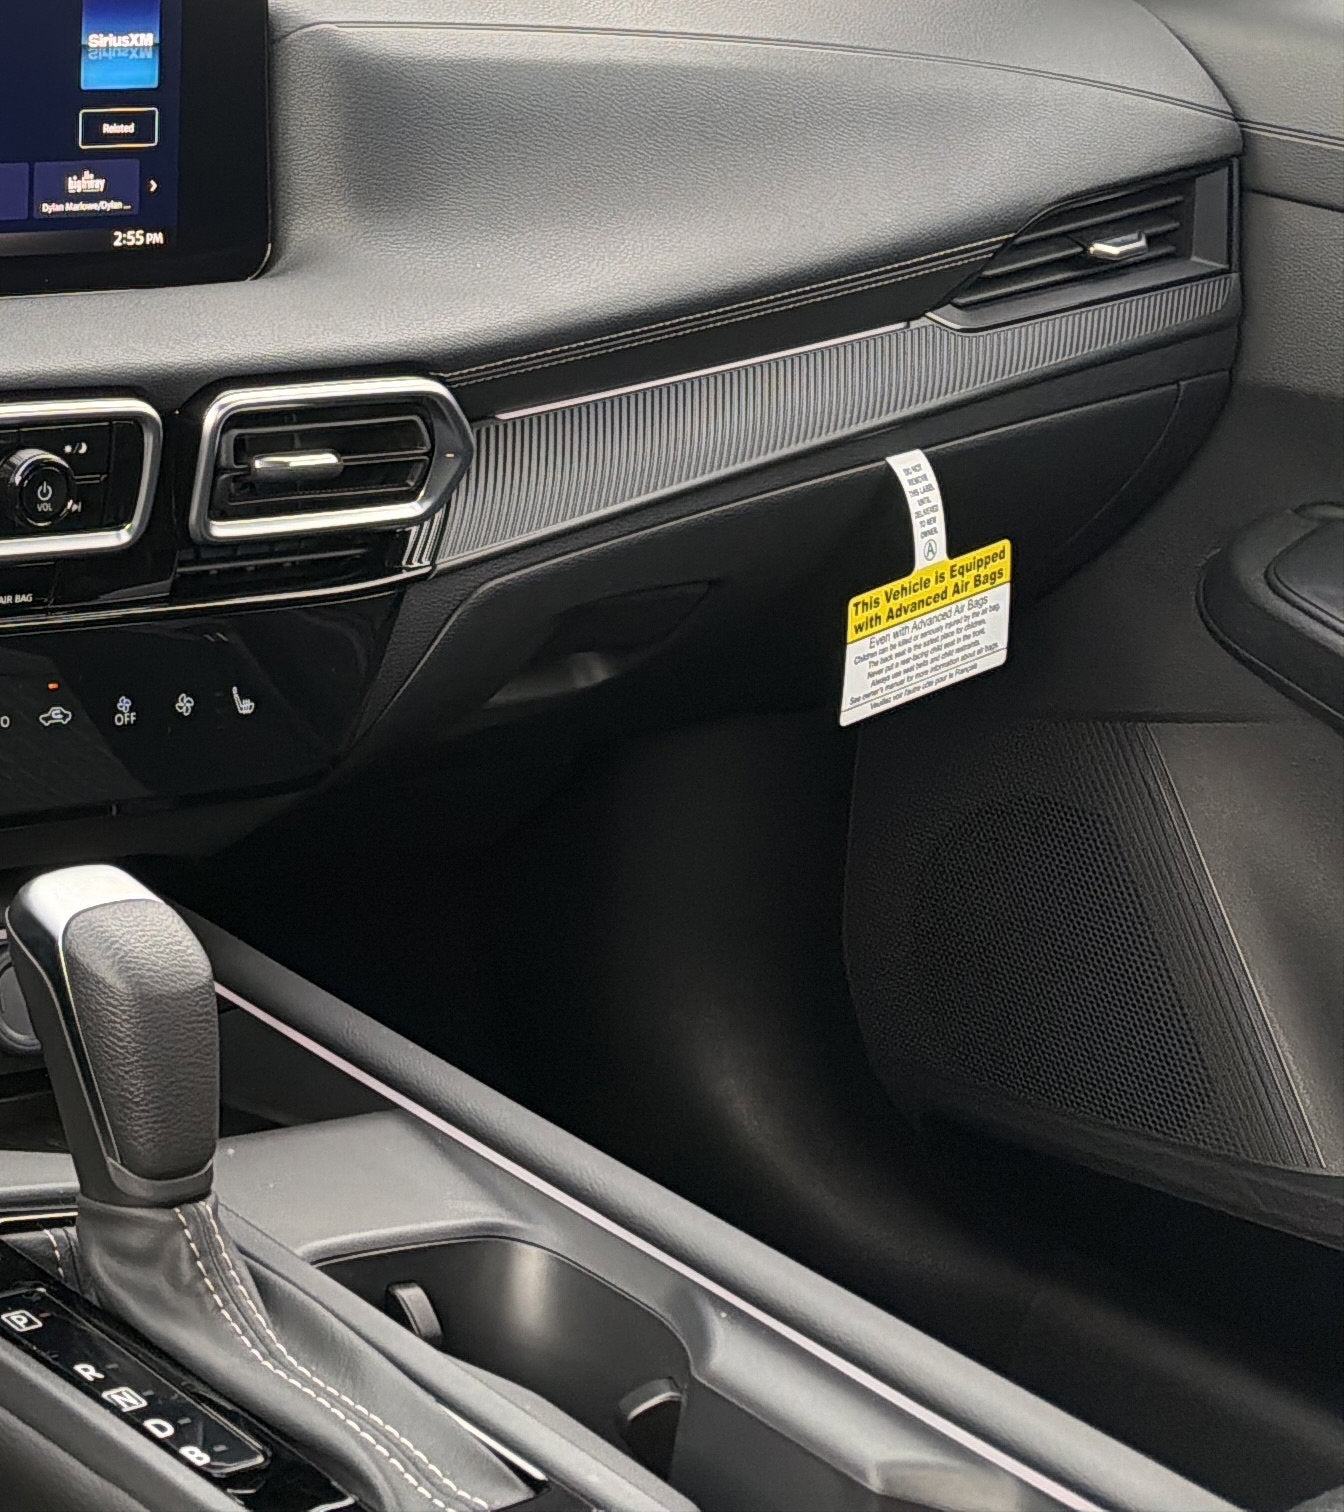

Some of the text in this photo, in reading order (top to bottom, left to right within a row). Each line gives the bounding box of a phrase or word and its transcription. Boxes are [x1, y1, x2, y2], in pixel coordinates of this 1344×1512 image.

[88, 32, 154, 48] SiriusXM
[102, 122, 135, 134] Related
[37, 503, 52, 512] VOL
[852, 545, 1005, 616] This Vehicle is Equipped
[14, 593, 33, 604] BAG
[853, 567, 1003, 634] with Advanced Air Bags
[869, 595, 988, 649] Even with Advanced Air Bags
[114, 712, 137, 726] OFF
[73, 1363, 105, 1381] R
[143, 1418, 175, 1439] D
[179, 1445, 211, 1467] B
